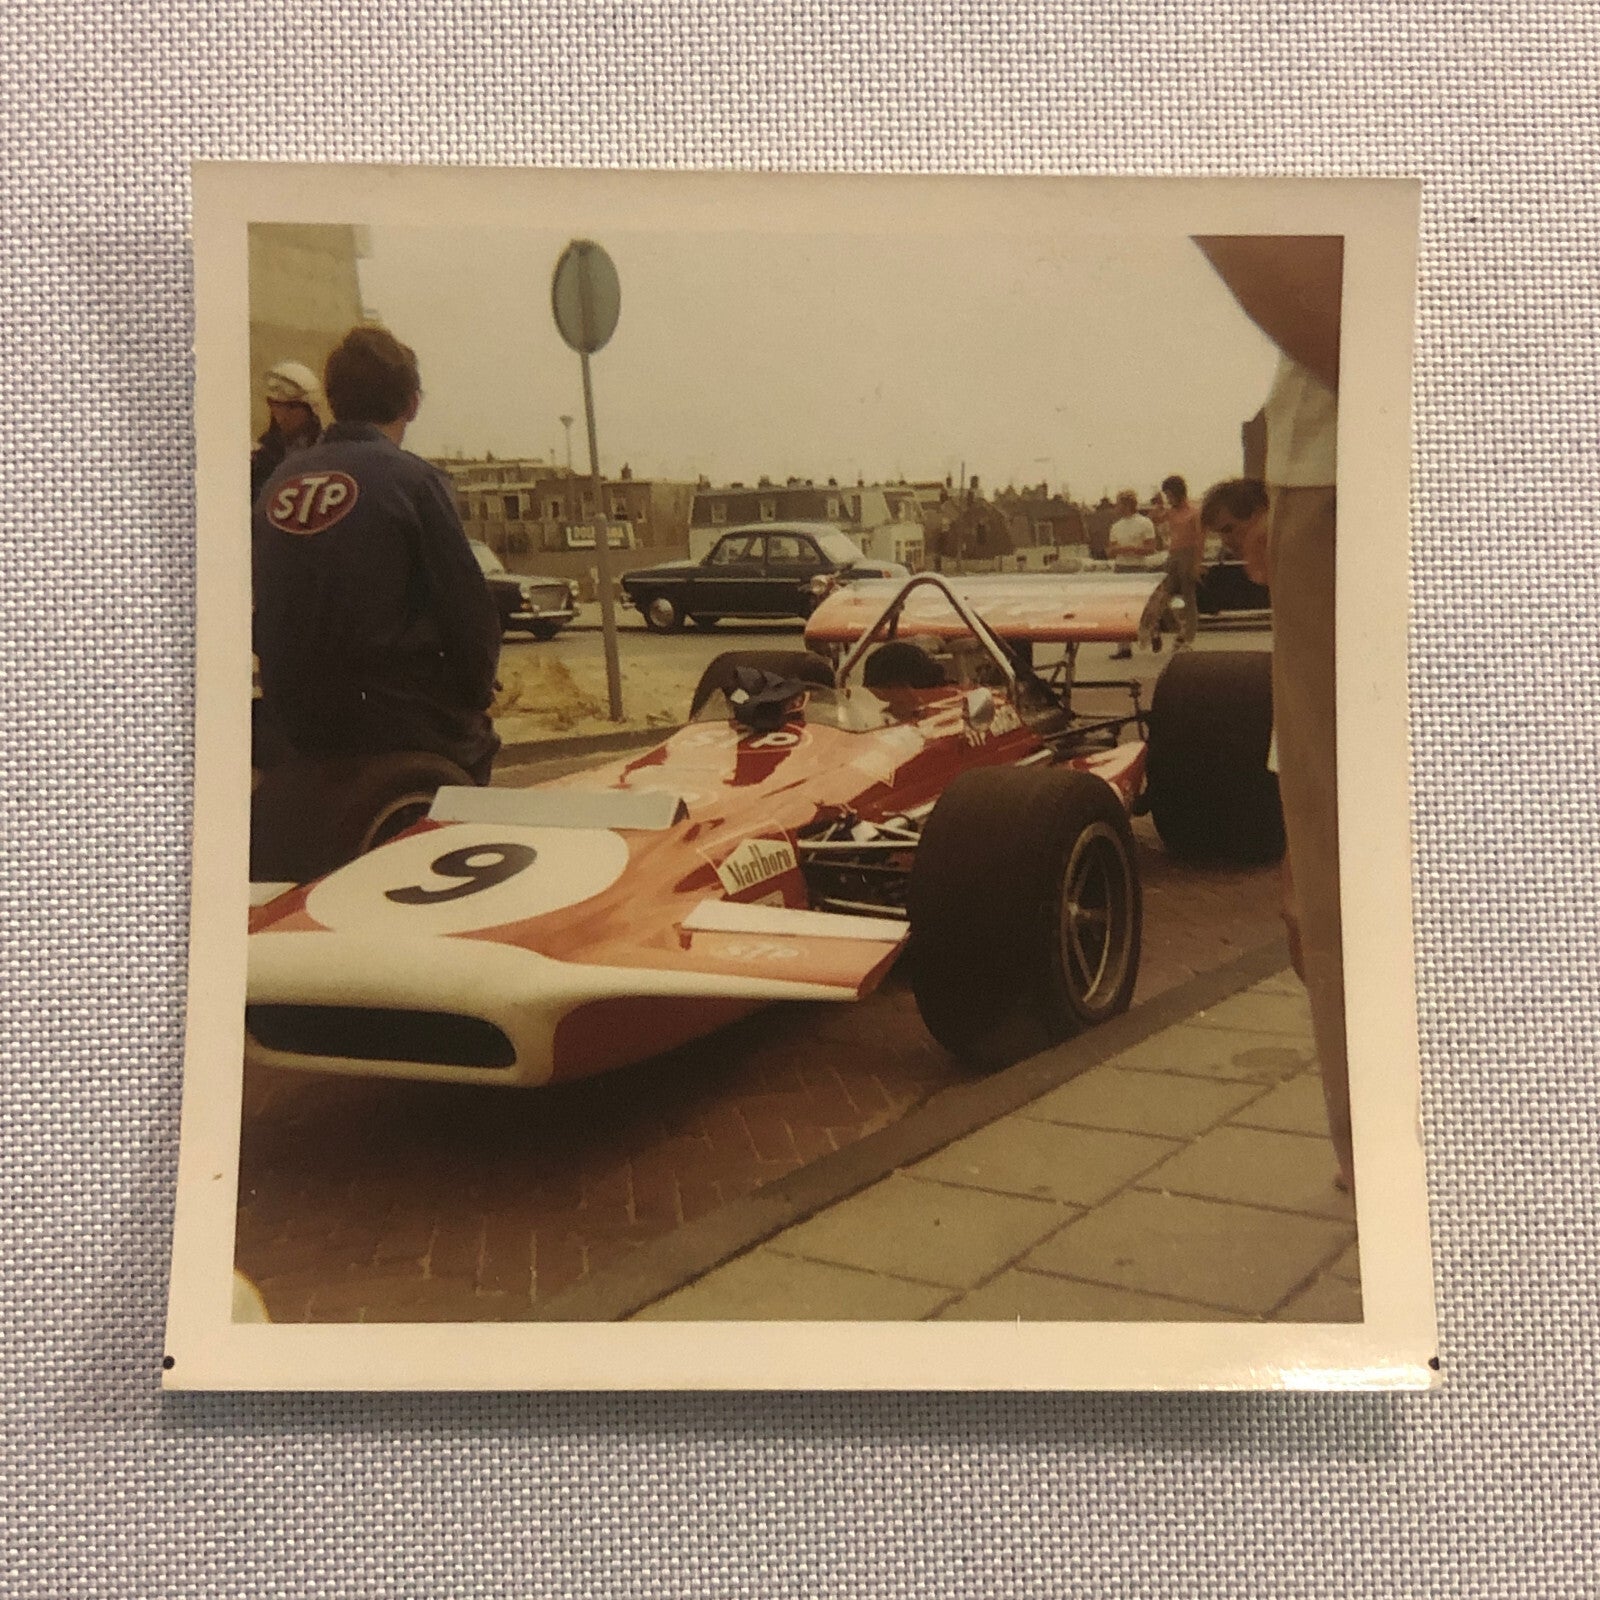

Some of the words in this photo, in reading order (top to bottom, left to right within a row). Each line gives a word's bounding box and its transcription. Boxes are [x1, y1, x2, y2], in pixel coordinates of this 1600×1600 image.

[273, 475, 348, 524] STP
[384, 843, 538, 905] 9
[726, 843, 793, 887] Marlboro
